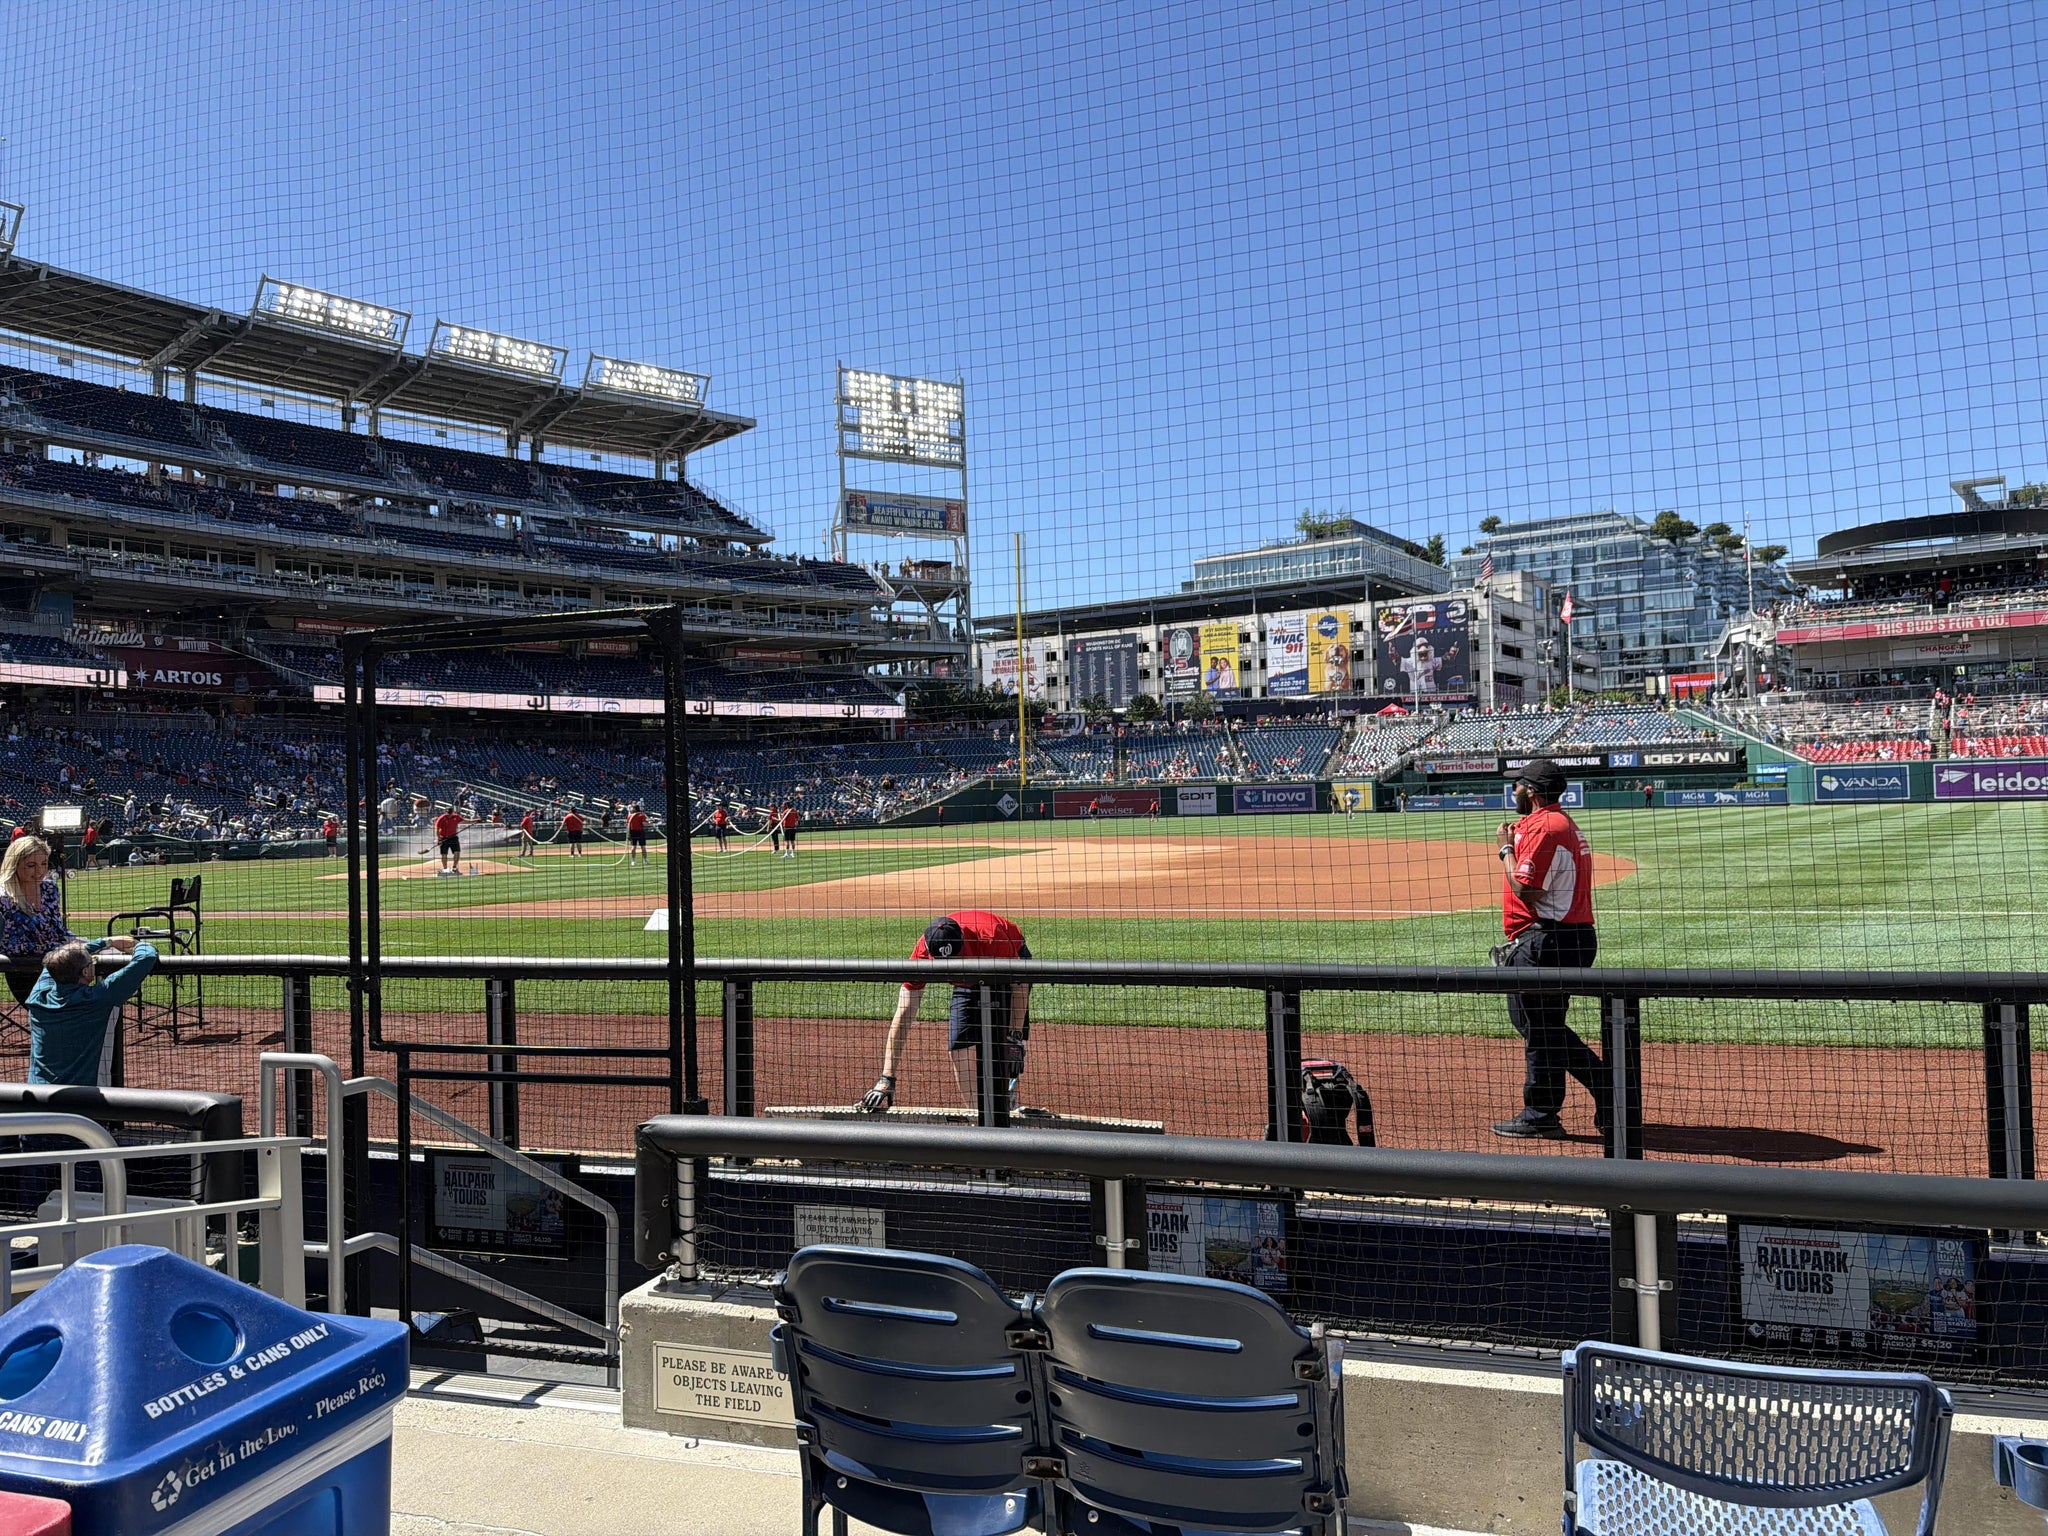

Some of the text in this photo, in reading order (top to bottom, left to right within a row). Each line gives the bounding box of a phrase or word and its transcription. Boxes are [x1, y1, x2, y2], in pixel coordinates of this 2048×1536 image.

[908, 509, 925, 518] VIEWS
[928, 511, 939, 519] AND
[871, 515, 892, 525] AWARD
[894, 517, 921, 527] WINNING
[1874, 614, 2009, 635] THIS BUD'S FOR YOU.
[1273, 633, 1304, 644] HVAC
[1285, 643, 1303, 653] 911
[1013, 658, 1025, 666] HOE
[154, 670, 222, 685] ARTOIS
[1582, 757, 1600, 766] PARK
[1689, 752, 1729, 763] FAN
[1435, 761, 1495, 771] Harris Teeter
[1838, 777, 1901, 788] VANDA
[1179, 792, 1215, 801] GDIT
[1262, 790, 1306, 802] inova
[1682, 792, 1705, 800] MGM
[1744, 791, 1770, 799] MGM
[444, 1171, 495, 1190] BALLPARK
[453, 1188, 487, 1205] TOURS
[842, 1217, 869, 1225] AWARE
[870, 1217, 880, 1225] OF
[806, 1225, 872, 1235] OBJECTS LEAVING
[821, 1234, 859, 1244] THE FIELD
[1149, 1232, 1178, 1253] URS
[1937, 1240, 1963, 1252] FOX
[1757, 1246, 1849, 1273] BALLPARK
[1774, 1269, 1833, 1294] TOURS
[1766, 1331, 1790, 1341] RAFFLE
[1882, 1341, 1916, 1349] JACKPOT
[144, 1323, 331, 1420] BOTTLES & CANS ONLY
[662, 1356, 706, 1372] PLEASE
[711, 1362, 726, 1374] BE
[732, 1364, 774, 1379] AWARE
[673, 1375, 783, 1398] OBJECTS LEAVING
[695, 1394, 761, 1412] THE FIELD
[0, 1411, 87, 1442] CANS ONLY
[185, 1464, 217, 1488] Get
[219, 1453, 236, 1470] in
[239, 1438, 264, 1460] the
[315, 1387, 356, 1420] Please
